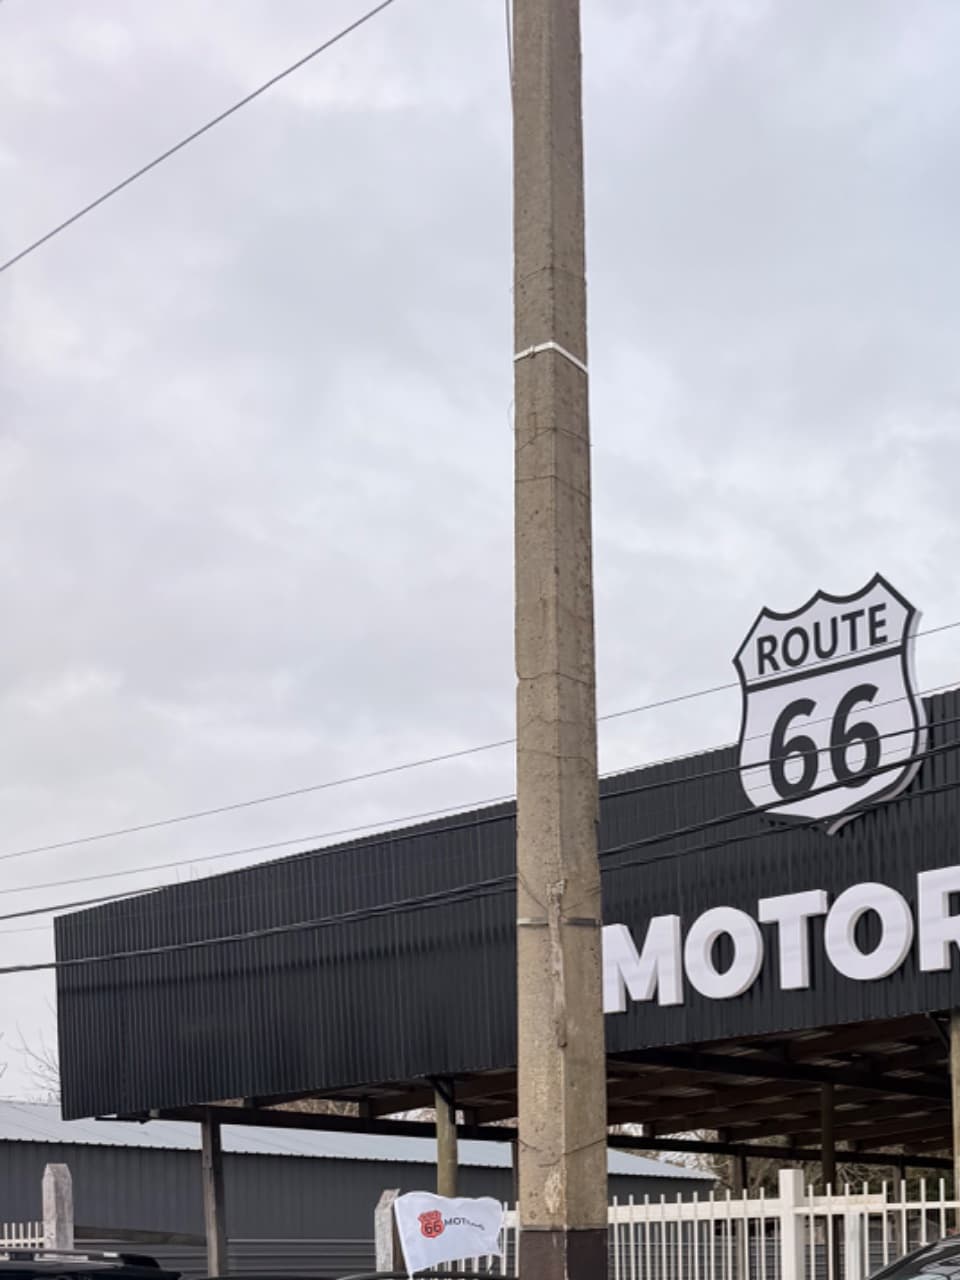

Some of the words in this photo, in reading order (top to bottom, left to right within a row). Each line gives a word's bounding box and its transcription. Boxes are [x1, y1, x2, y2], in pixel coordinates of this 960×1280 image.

[756, 602, 888, 675] ROUTE
[769, 683, 882, 800] 66
[424, 1220, 442, 1234] 66
